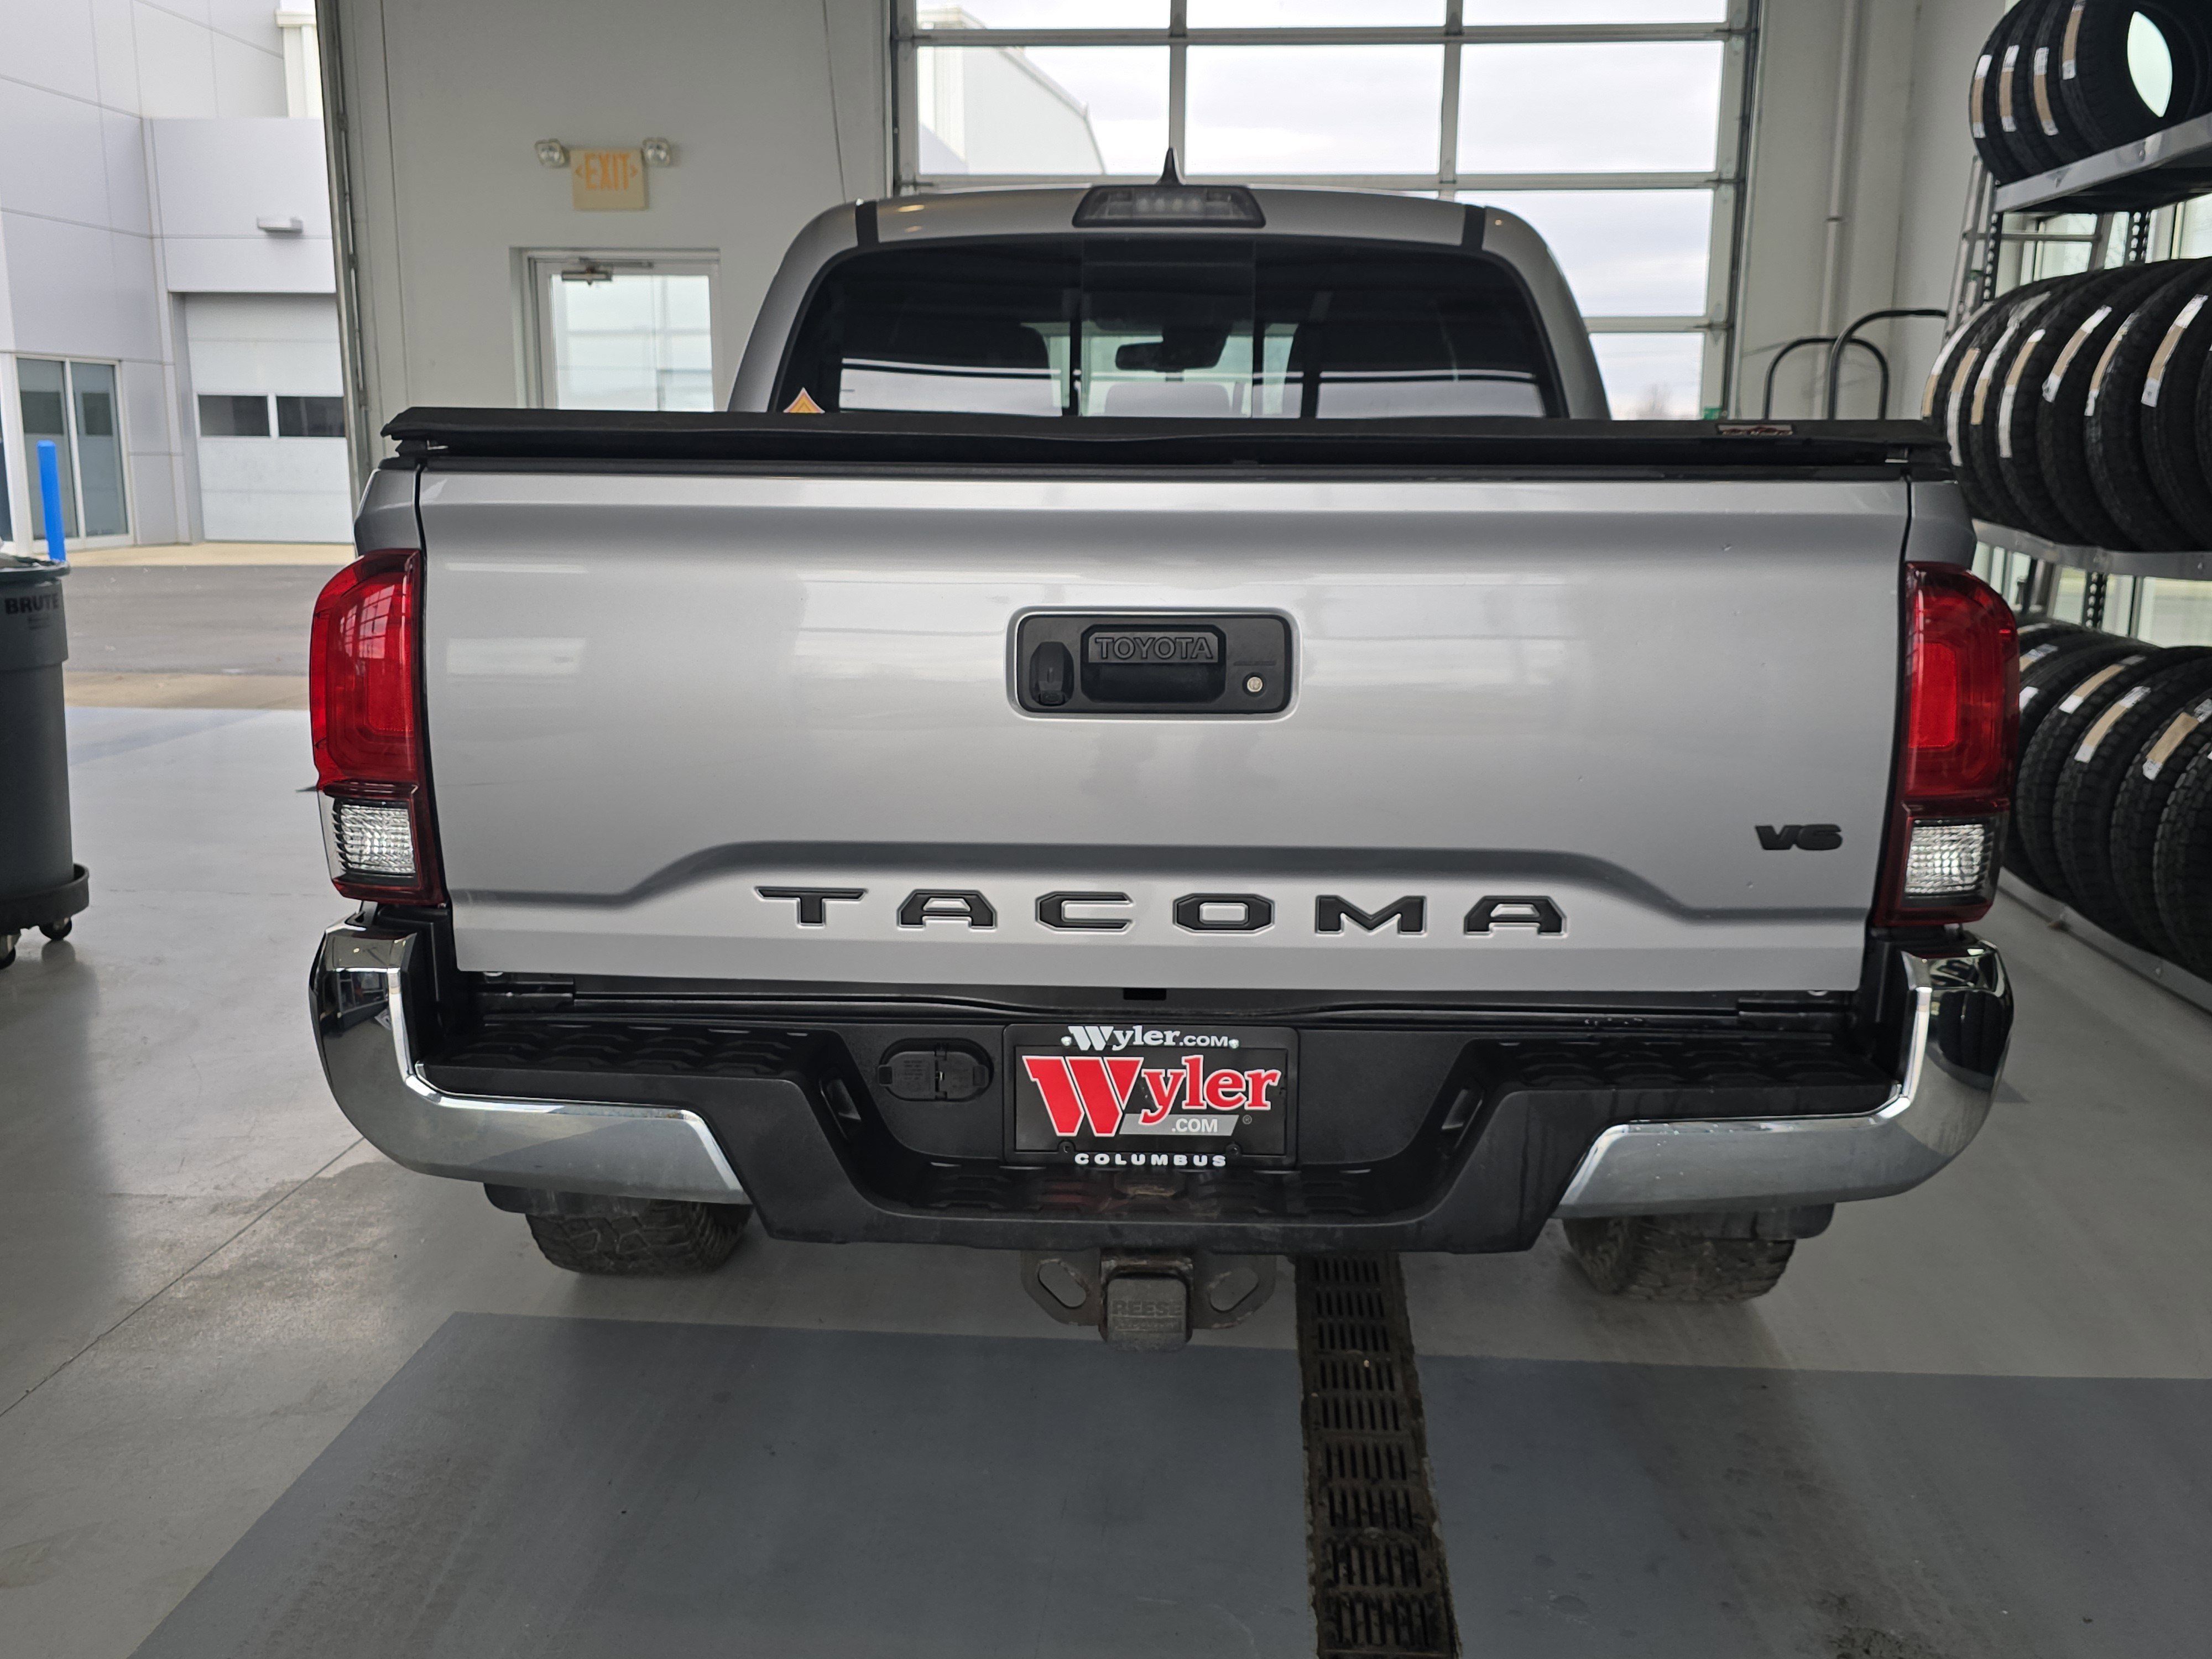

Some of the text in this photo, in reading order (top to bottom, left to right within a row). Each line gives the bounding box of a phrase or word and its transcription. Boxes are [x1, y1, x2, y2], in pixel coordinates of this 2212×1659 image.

[585, 153, 629, 191] EXIT
[4, 593, 59, 614] BRUTE
[1095, 637, 1213, 659] TOYOTA
[1755, 824, 1843, 851] V6
[755, 886, 1567, 937] TACOMA
[1022, 1055, 1281, 1137] Wyler
[1171, 1118, 1218, 1133] .COM
[1074, 1154, 1227, 1167] COLUMBUS
[1112, 1300, 1182, 1316] REESE
